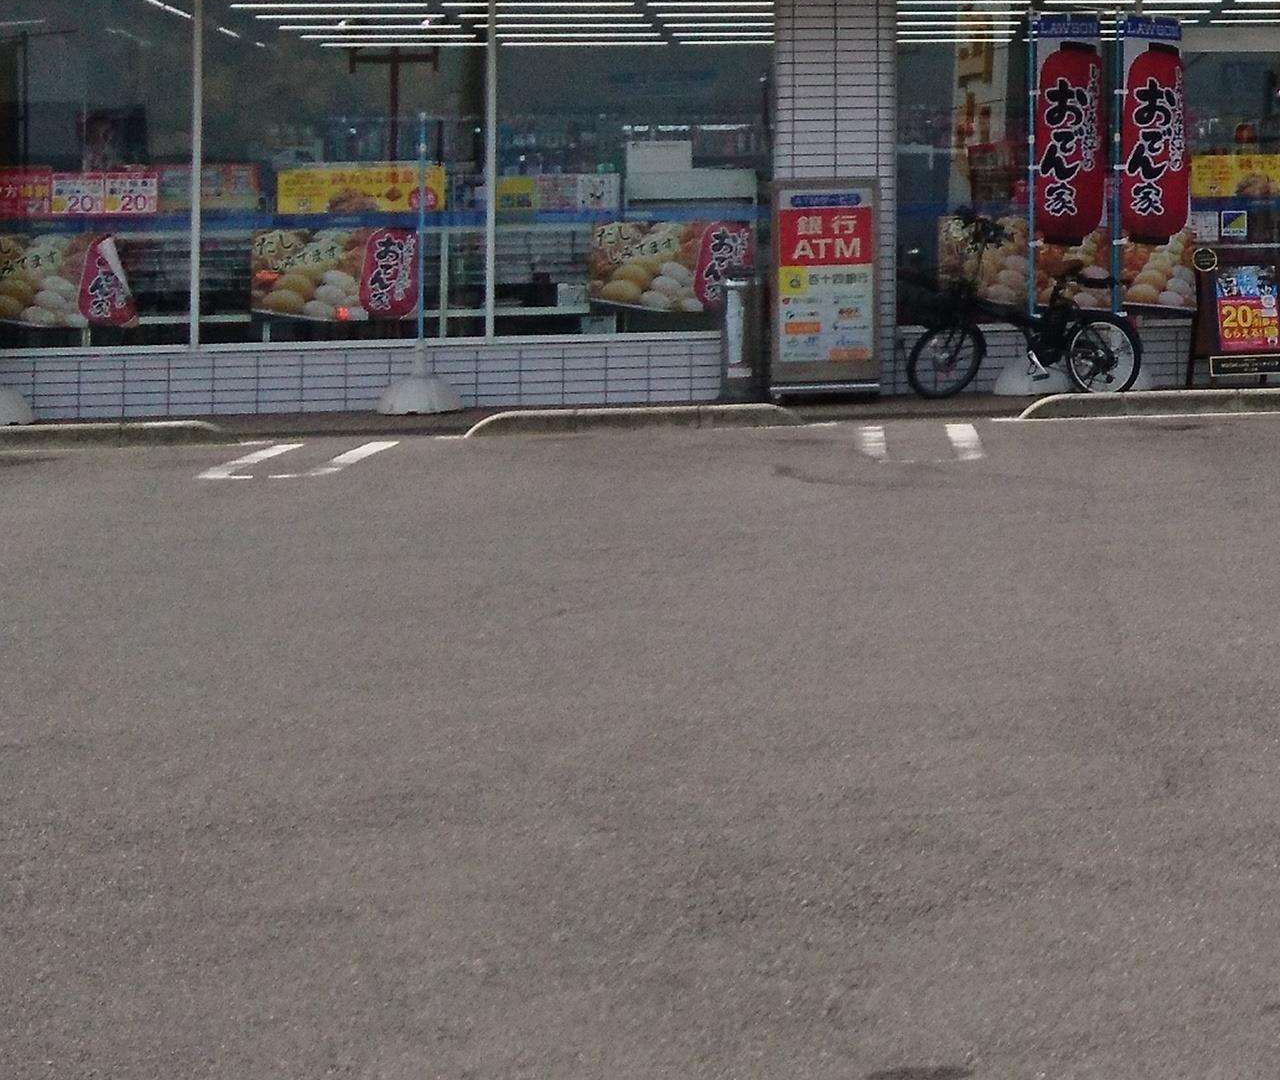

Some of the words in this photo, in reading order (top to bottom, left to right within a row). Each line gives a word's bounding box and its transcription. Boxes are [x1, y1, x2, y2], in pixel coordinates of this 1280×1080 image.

[1039, 21, 1097, 36] LAWSON
[1127, 21, 1180, 37] LAWSON
[1040, 77, 1088, 215] おでん家
[1127, 77, 1176, 215] おでん家
[796, 215, 858, 235] 銀行
[791, 237, 862, 260] ATM
